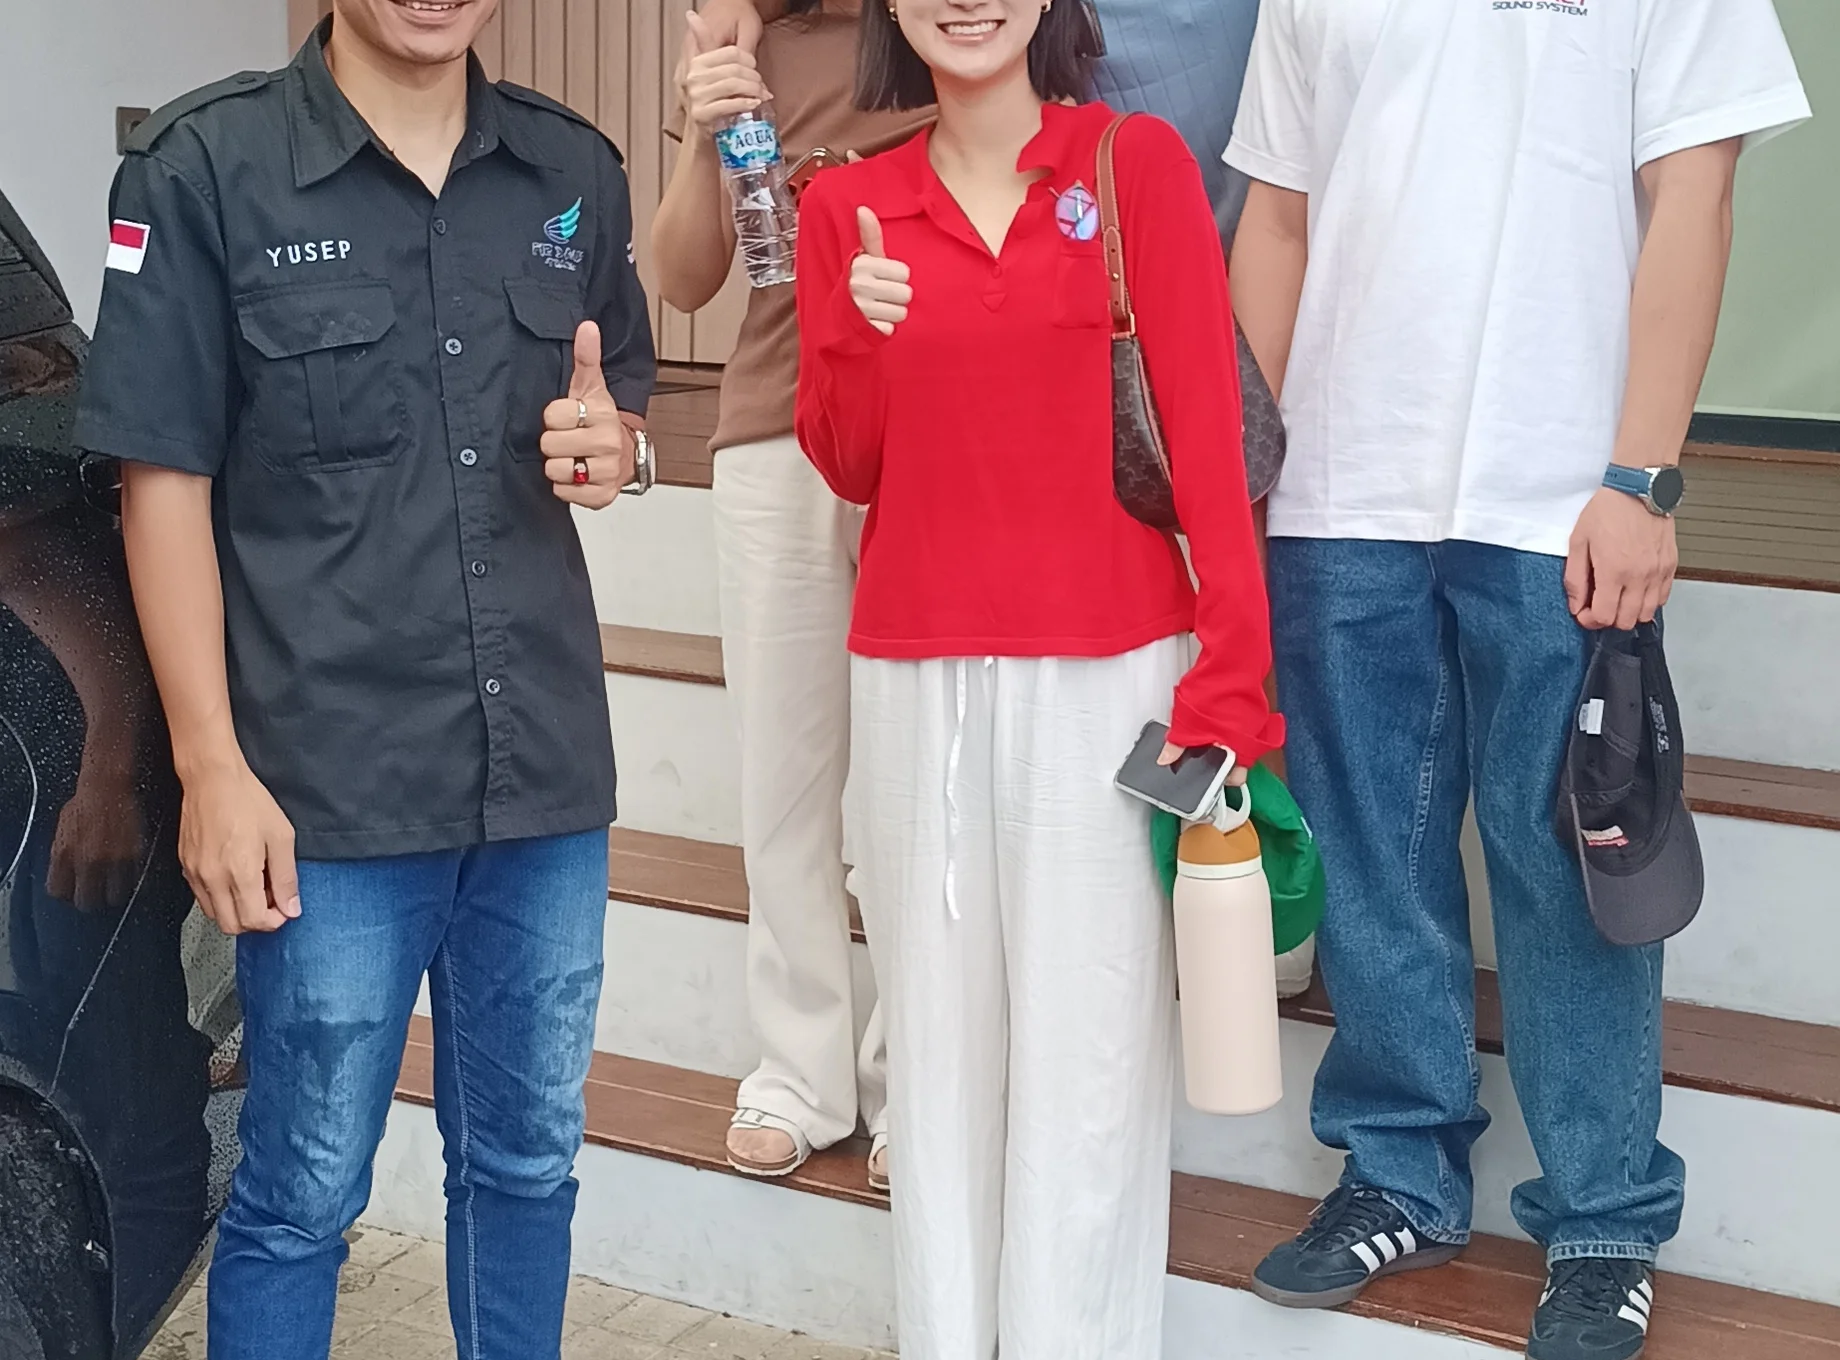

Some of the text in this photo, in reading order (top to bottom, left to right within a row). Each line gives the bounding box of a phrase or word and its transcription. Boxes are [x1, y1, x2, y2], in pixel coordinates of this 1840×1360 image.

[1492, 0, 1588, 16] SOUND SYSTEM
[734, 129, 773, 149] AQUA
[265, 240, 351, 268] YUSEP
